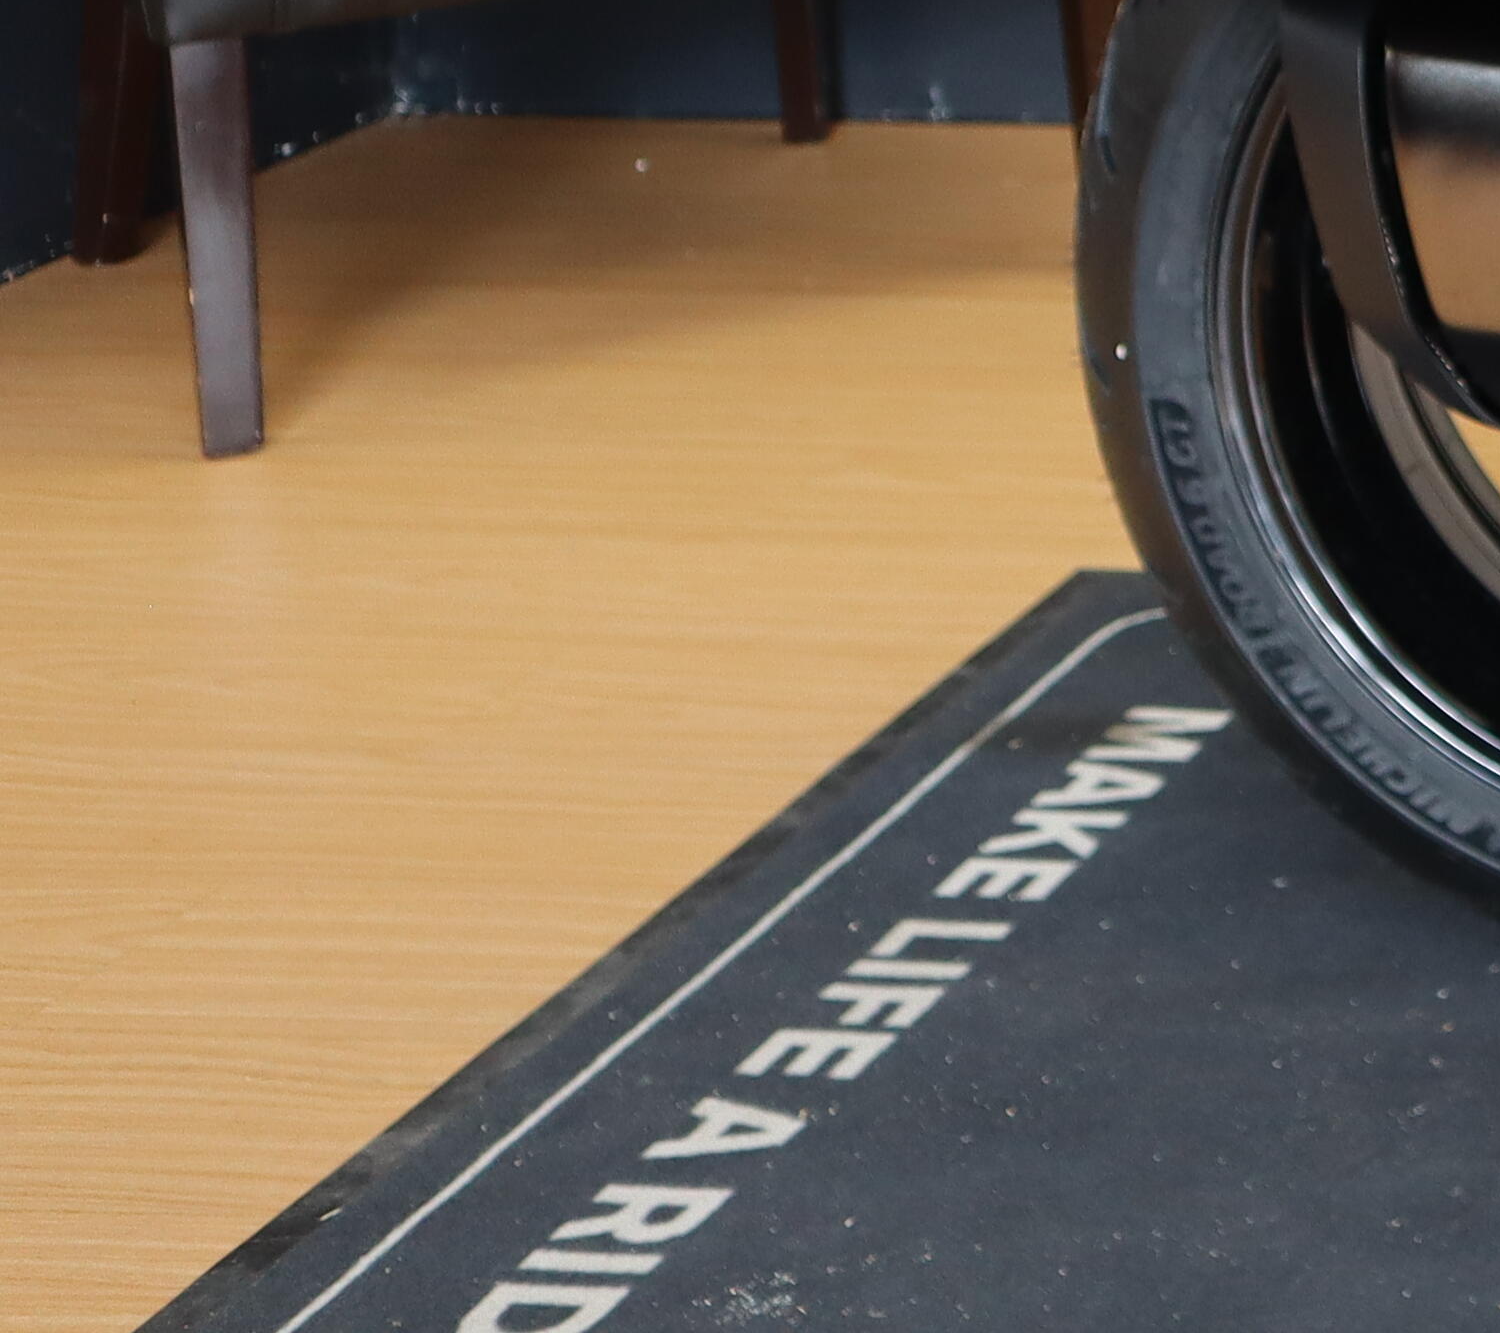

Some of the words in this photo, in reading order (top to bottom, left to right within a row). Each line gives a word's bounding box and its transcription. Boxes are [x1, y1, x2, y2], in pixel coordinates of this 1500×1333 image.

[1157, 413, 1198, 468] GT
[934, 705, 1233, 902] MAKE
[1272, 656, 1482, 837] MICHELIN
[736, 919, 1011, 1081] LIFE
[641, 1096, 807, 1160] A
